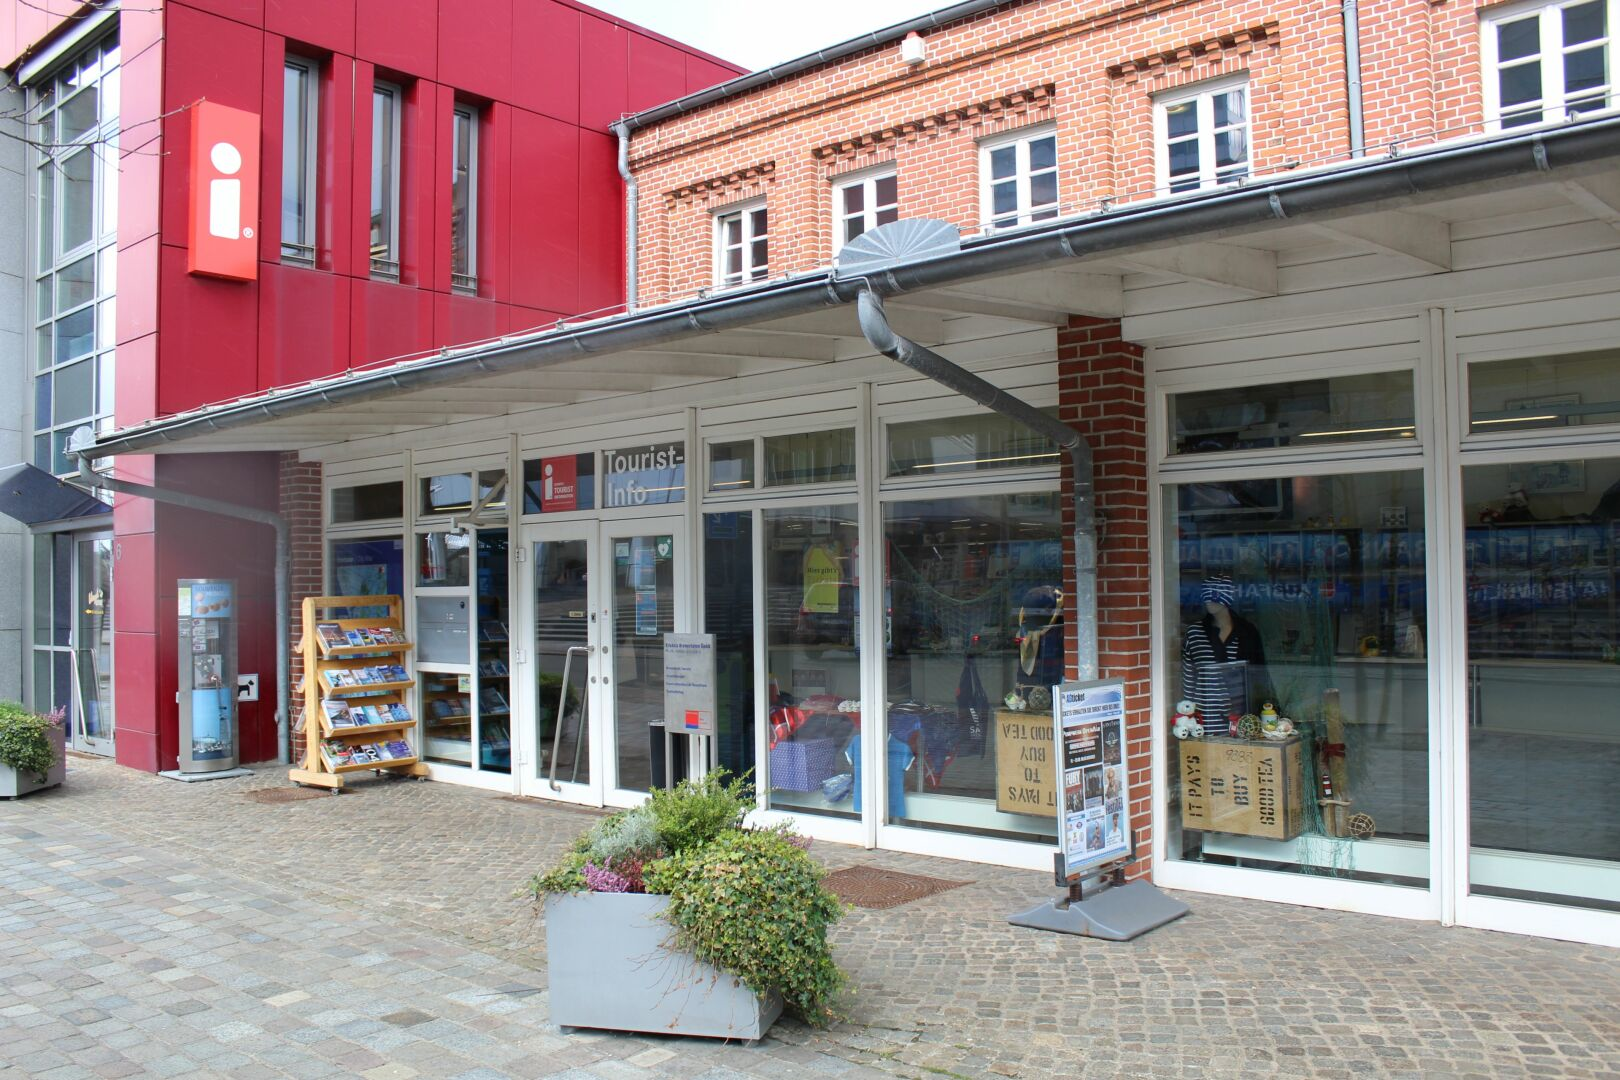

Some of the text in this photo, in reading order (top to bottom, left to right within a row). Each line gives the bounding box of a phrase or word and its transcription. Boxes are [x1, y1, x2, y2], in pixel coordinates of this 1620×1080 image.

[604, 446, 684, 474] Tourist-
[554, 486, 574, 494] TOURIST
[608, 480, 648, 507] Info
[1002, 722, 1027, 740] TEA
[1030, 726, 1054, 741] OOD
[1020, 746, 1046, 762] BUY
[1024, 767, 1041, 783] TO
[1066, 770, 1080, 787] FURY
[1008, 786, 1040, 805] PAYS
[1186, 755, 1203, 818] IT PAYS
[1211, 777, 1224, 796] TO
[1232, 774, 1249, 806] BUY
[1257, 758, 1275, 825] GOOD TEA
